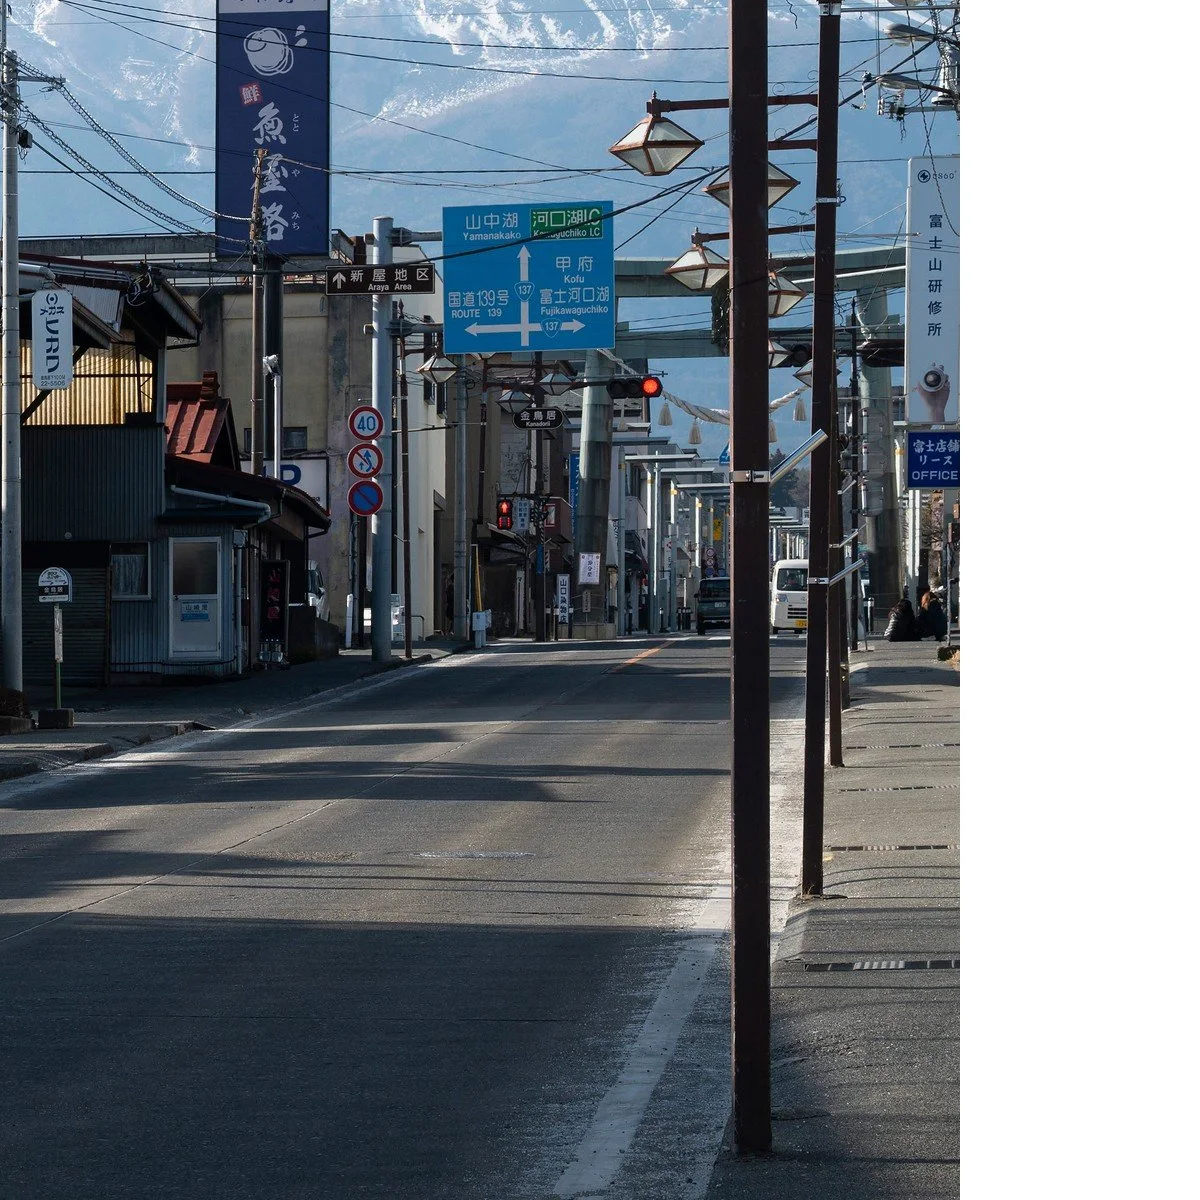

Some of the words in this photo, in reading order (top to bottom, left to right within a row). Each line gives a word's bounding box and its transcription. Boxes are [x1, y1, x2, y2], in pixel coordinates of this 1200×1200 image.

[241, 85, 260, 104] 鮮
[465, 212, 519, 230] 山中湖
[463, 232, 521, 241] Yamanakako
[533, 229, 587, 240] Kaaguchiko
[556, 256, 593, 272] 甲府
[350, 268, 429, 282] 新屋地区
[564, 275, 585, 284] Kofu
[927, 213, 943, 337] 富士山研修所
[368, 283, 390, 291] Araya
[394, 283, 412, 291] Area
[518, 285, 532, 295] 137
[448, 289, 510, 308] 国道139号
[540, 286, 610, 304] 富士河口湖
[452, 309, 480, 318] ROUTE
[487, 309, 502, 318] 139
[541, 305, 609, 316] Fujikawaguchiko
[545, 321, 559, 330] 137
[357, 415, 376, 431] 40
[920, 455, 952, 465] リース
[912, 471, 958, 480] OFFICE
